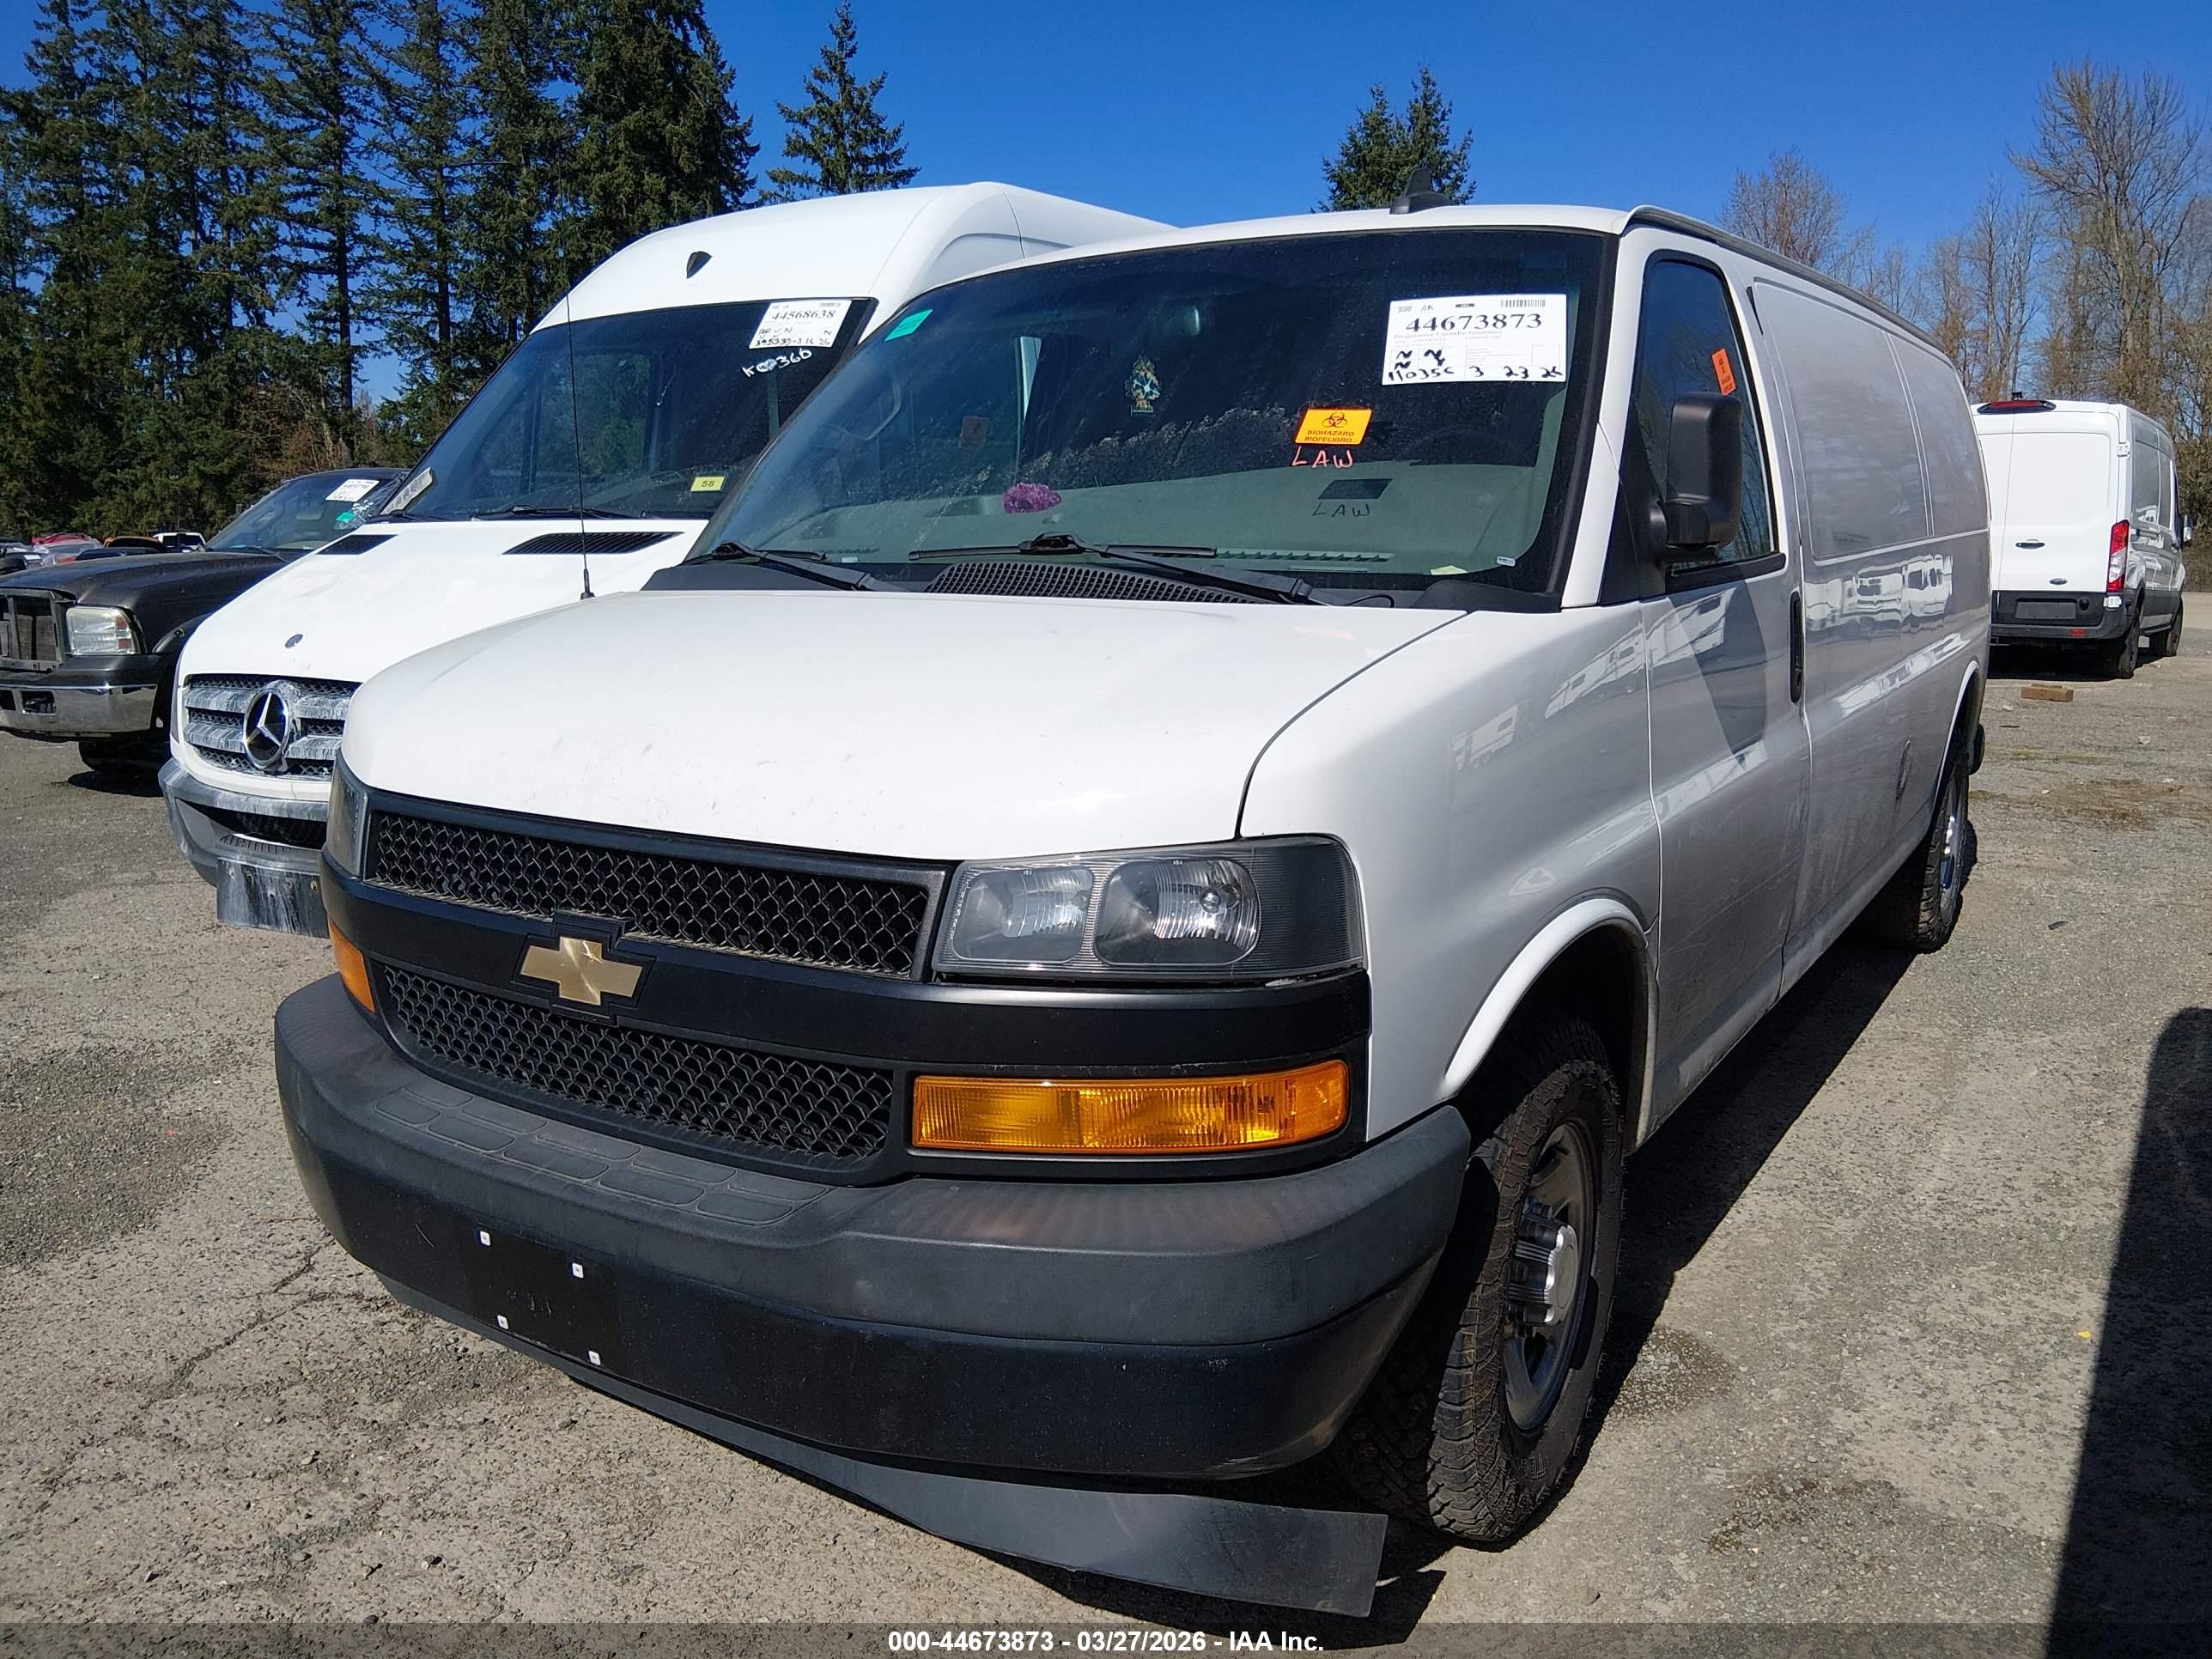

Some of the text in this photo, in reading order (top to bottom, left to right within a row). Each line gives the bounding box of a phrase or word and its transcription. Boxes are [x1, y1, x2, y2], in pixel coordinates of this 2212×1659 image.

[772, 309, 836, 320] 44568638
[1406, 313, 1542, 332] 44673873
[1469, 365, 1485, 378] 3
[1503, 366, 1530, 380] 23
[1291, 446, 1354, 469] LAW
